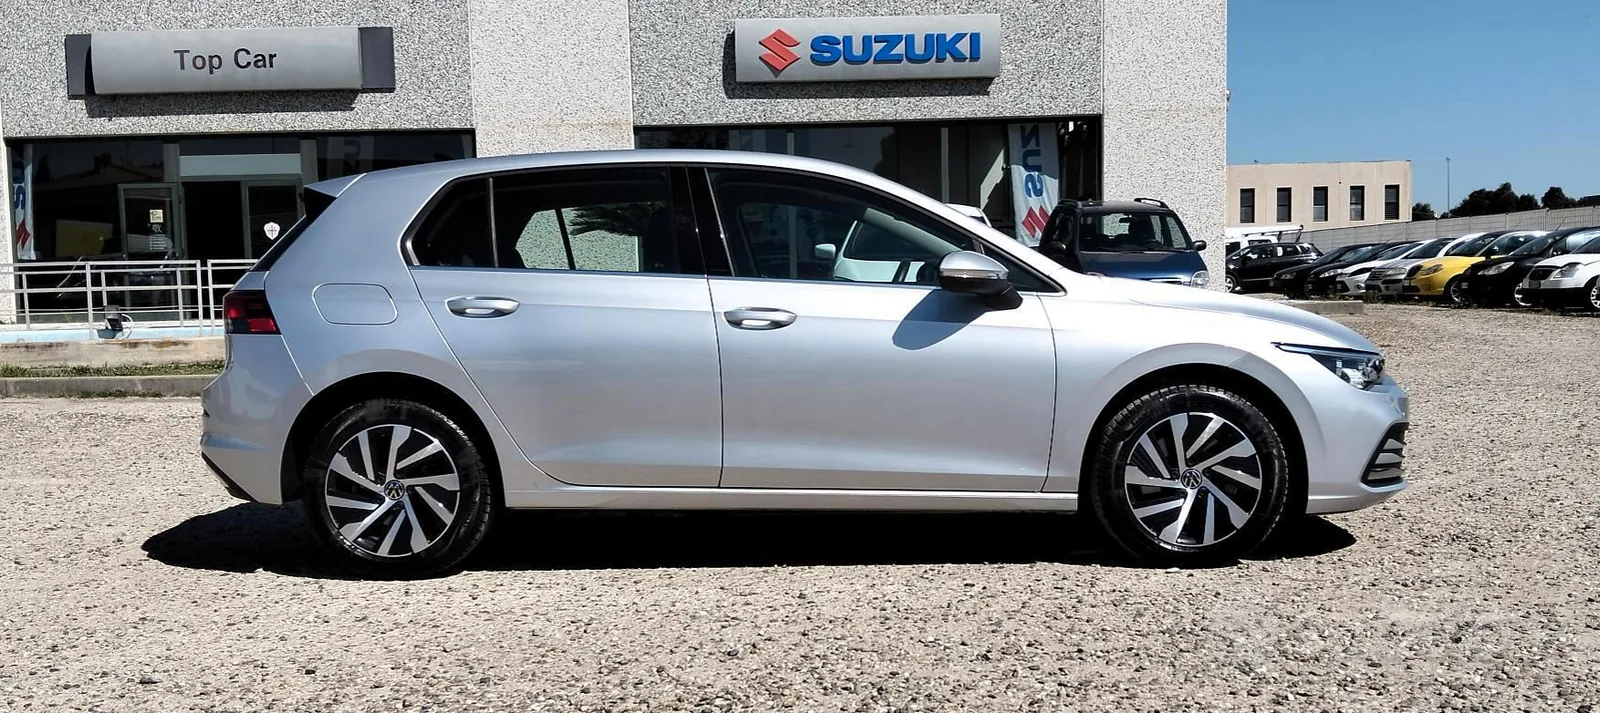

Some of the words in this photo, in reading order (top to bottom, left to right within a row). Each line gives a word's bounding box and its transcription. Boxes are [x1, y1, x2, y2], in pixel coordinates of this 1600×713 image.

[173, 49, 223, 75] Top
[233, 47, 277, 69] Car
[810, 32, 981, 65] SUZUKI
